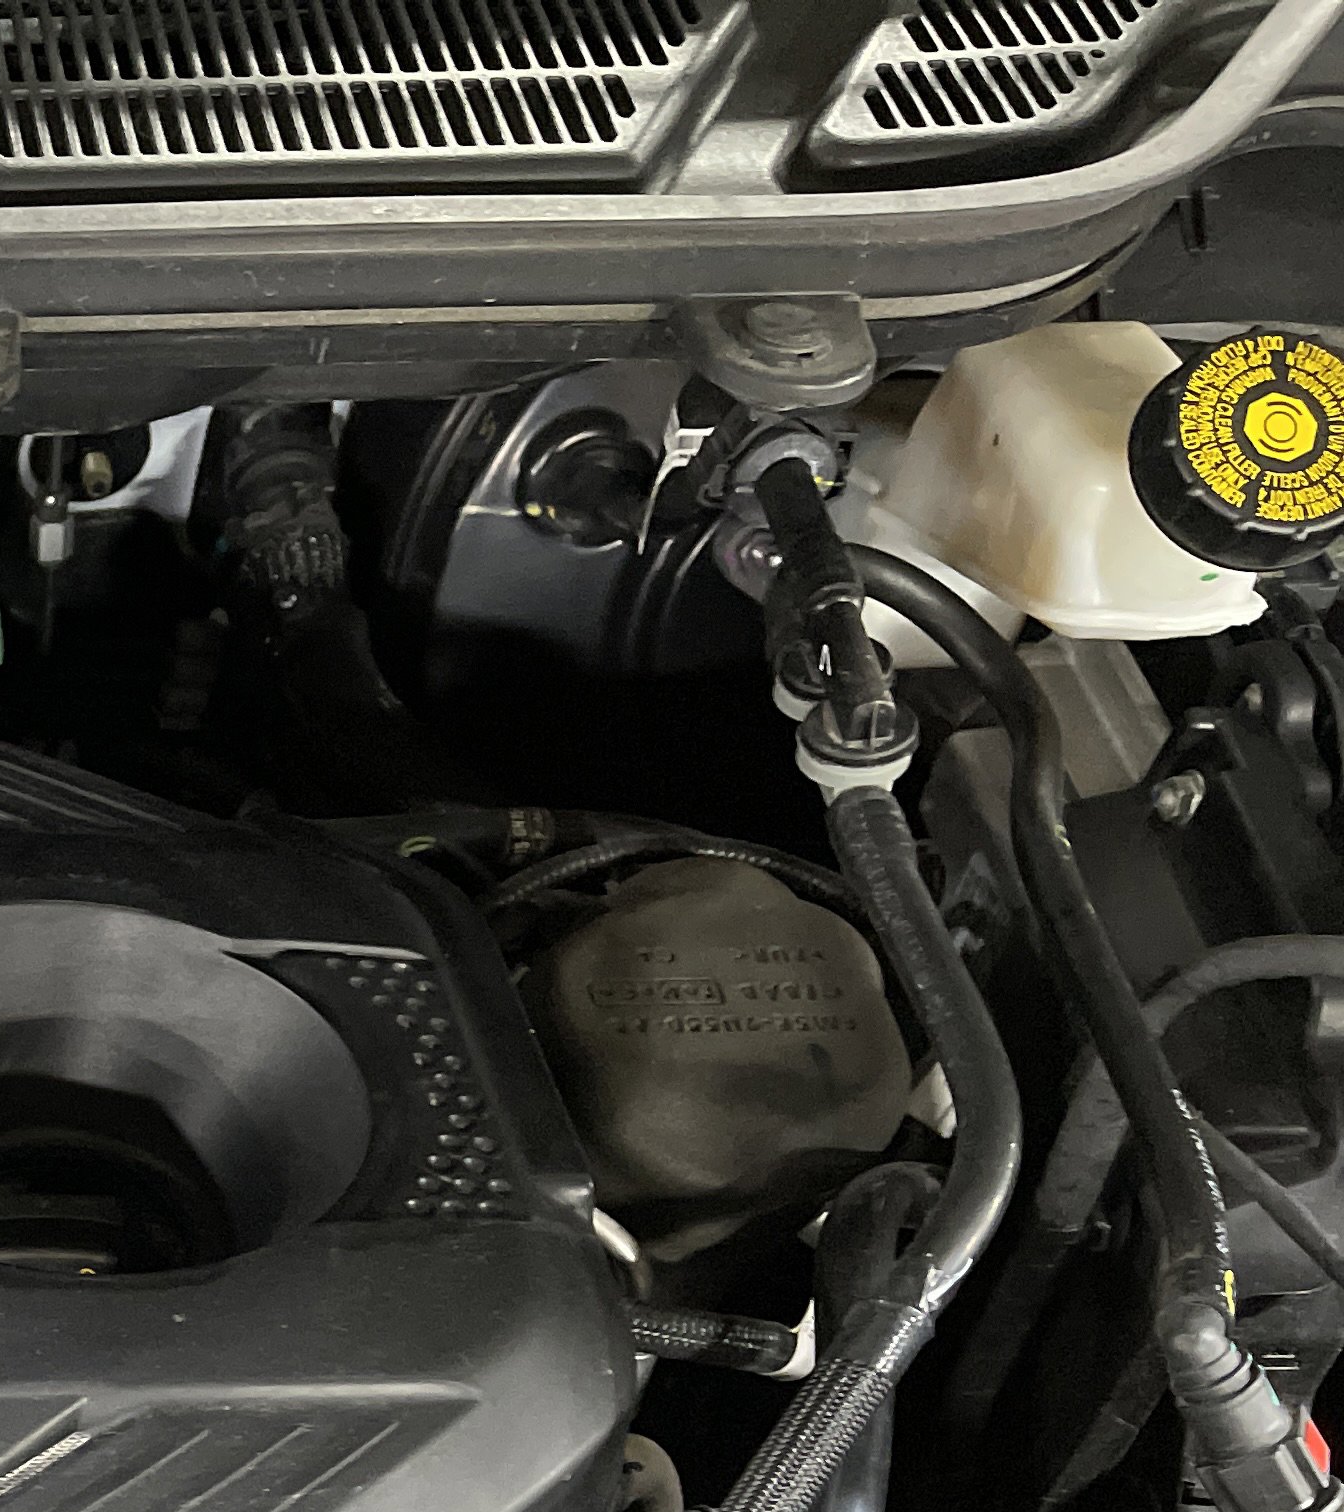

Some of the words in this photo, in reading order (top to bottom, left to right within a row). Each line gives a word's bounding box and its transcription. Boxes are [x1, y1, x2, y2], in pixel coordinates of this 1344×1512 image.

[1210, 341, 1247, 367] FLUID
[1244, 339, 1255, 353] 4
[1247, 350, 1272, 367] CAP
[1257, 336, 1284, 351] DOT
[1186, 360, 1217, 394] FROM
[1221, 366, 1276, 404] WARNING
[1182, 391, 1199, 402] A
[1179, 403, 1201, 449] SEALED
[1197, 385, 1220, 443] REMOVING
[1215, 403, 1235, 443] CLEAN
[1201, 442, 1226, 469] USE
[1221, 443, 1261, 480] FILLER
[1187, 450, 1247, 508] CONTAINER
